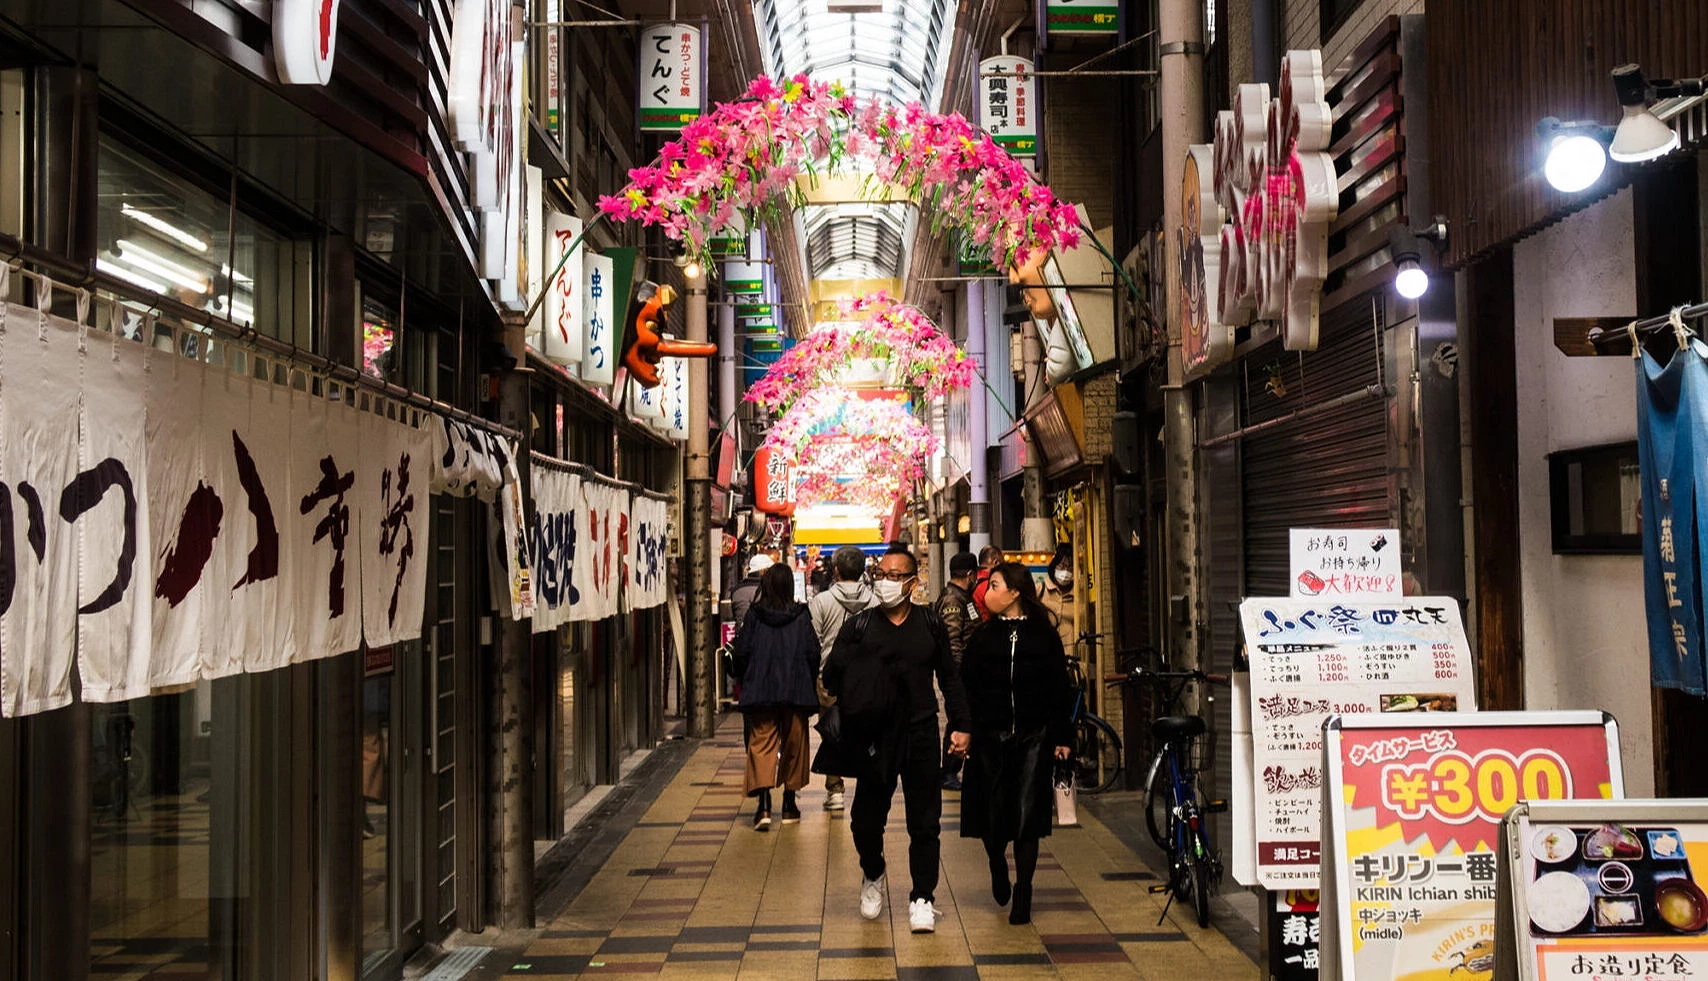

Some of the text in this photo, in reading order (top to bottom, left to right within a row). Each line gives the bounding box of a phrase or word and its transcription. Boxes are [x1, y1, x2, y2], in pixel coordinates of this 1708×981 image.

[652, 35, 673, 105] てんぐ
[590, 267, 605, 369] 串かつ
[768, 453, 788, 503] 新鮮
[1307, 535, 1348, 552] お寿司
[1320, 555, 1382, 571] お持ち帰り
[1259, 605, 1362, 638] ふぐ祭
[1402, 606, 1449, 625] 丸天
[1258, 693, 1330, 721] 満足コース
[1351, 731, 1455, 763] タイムサービス
[1391, 758, 1563, 814] ¥300
[1357, 887, 1403, 901] KIRIN
[1408, 886, 1458, 900] Ichian
[1359, 908, 1422, 924] 中ジョッキ
[1359, 926, 1403, 940] (midle)
[1432, 925, 1476, 962] KIRIN'S
[1571, 953, 1693, 976] お造り定食
